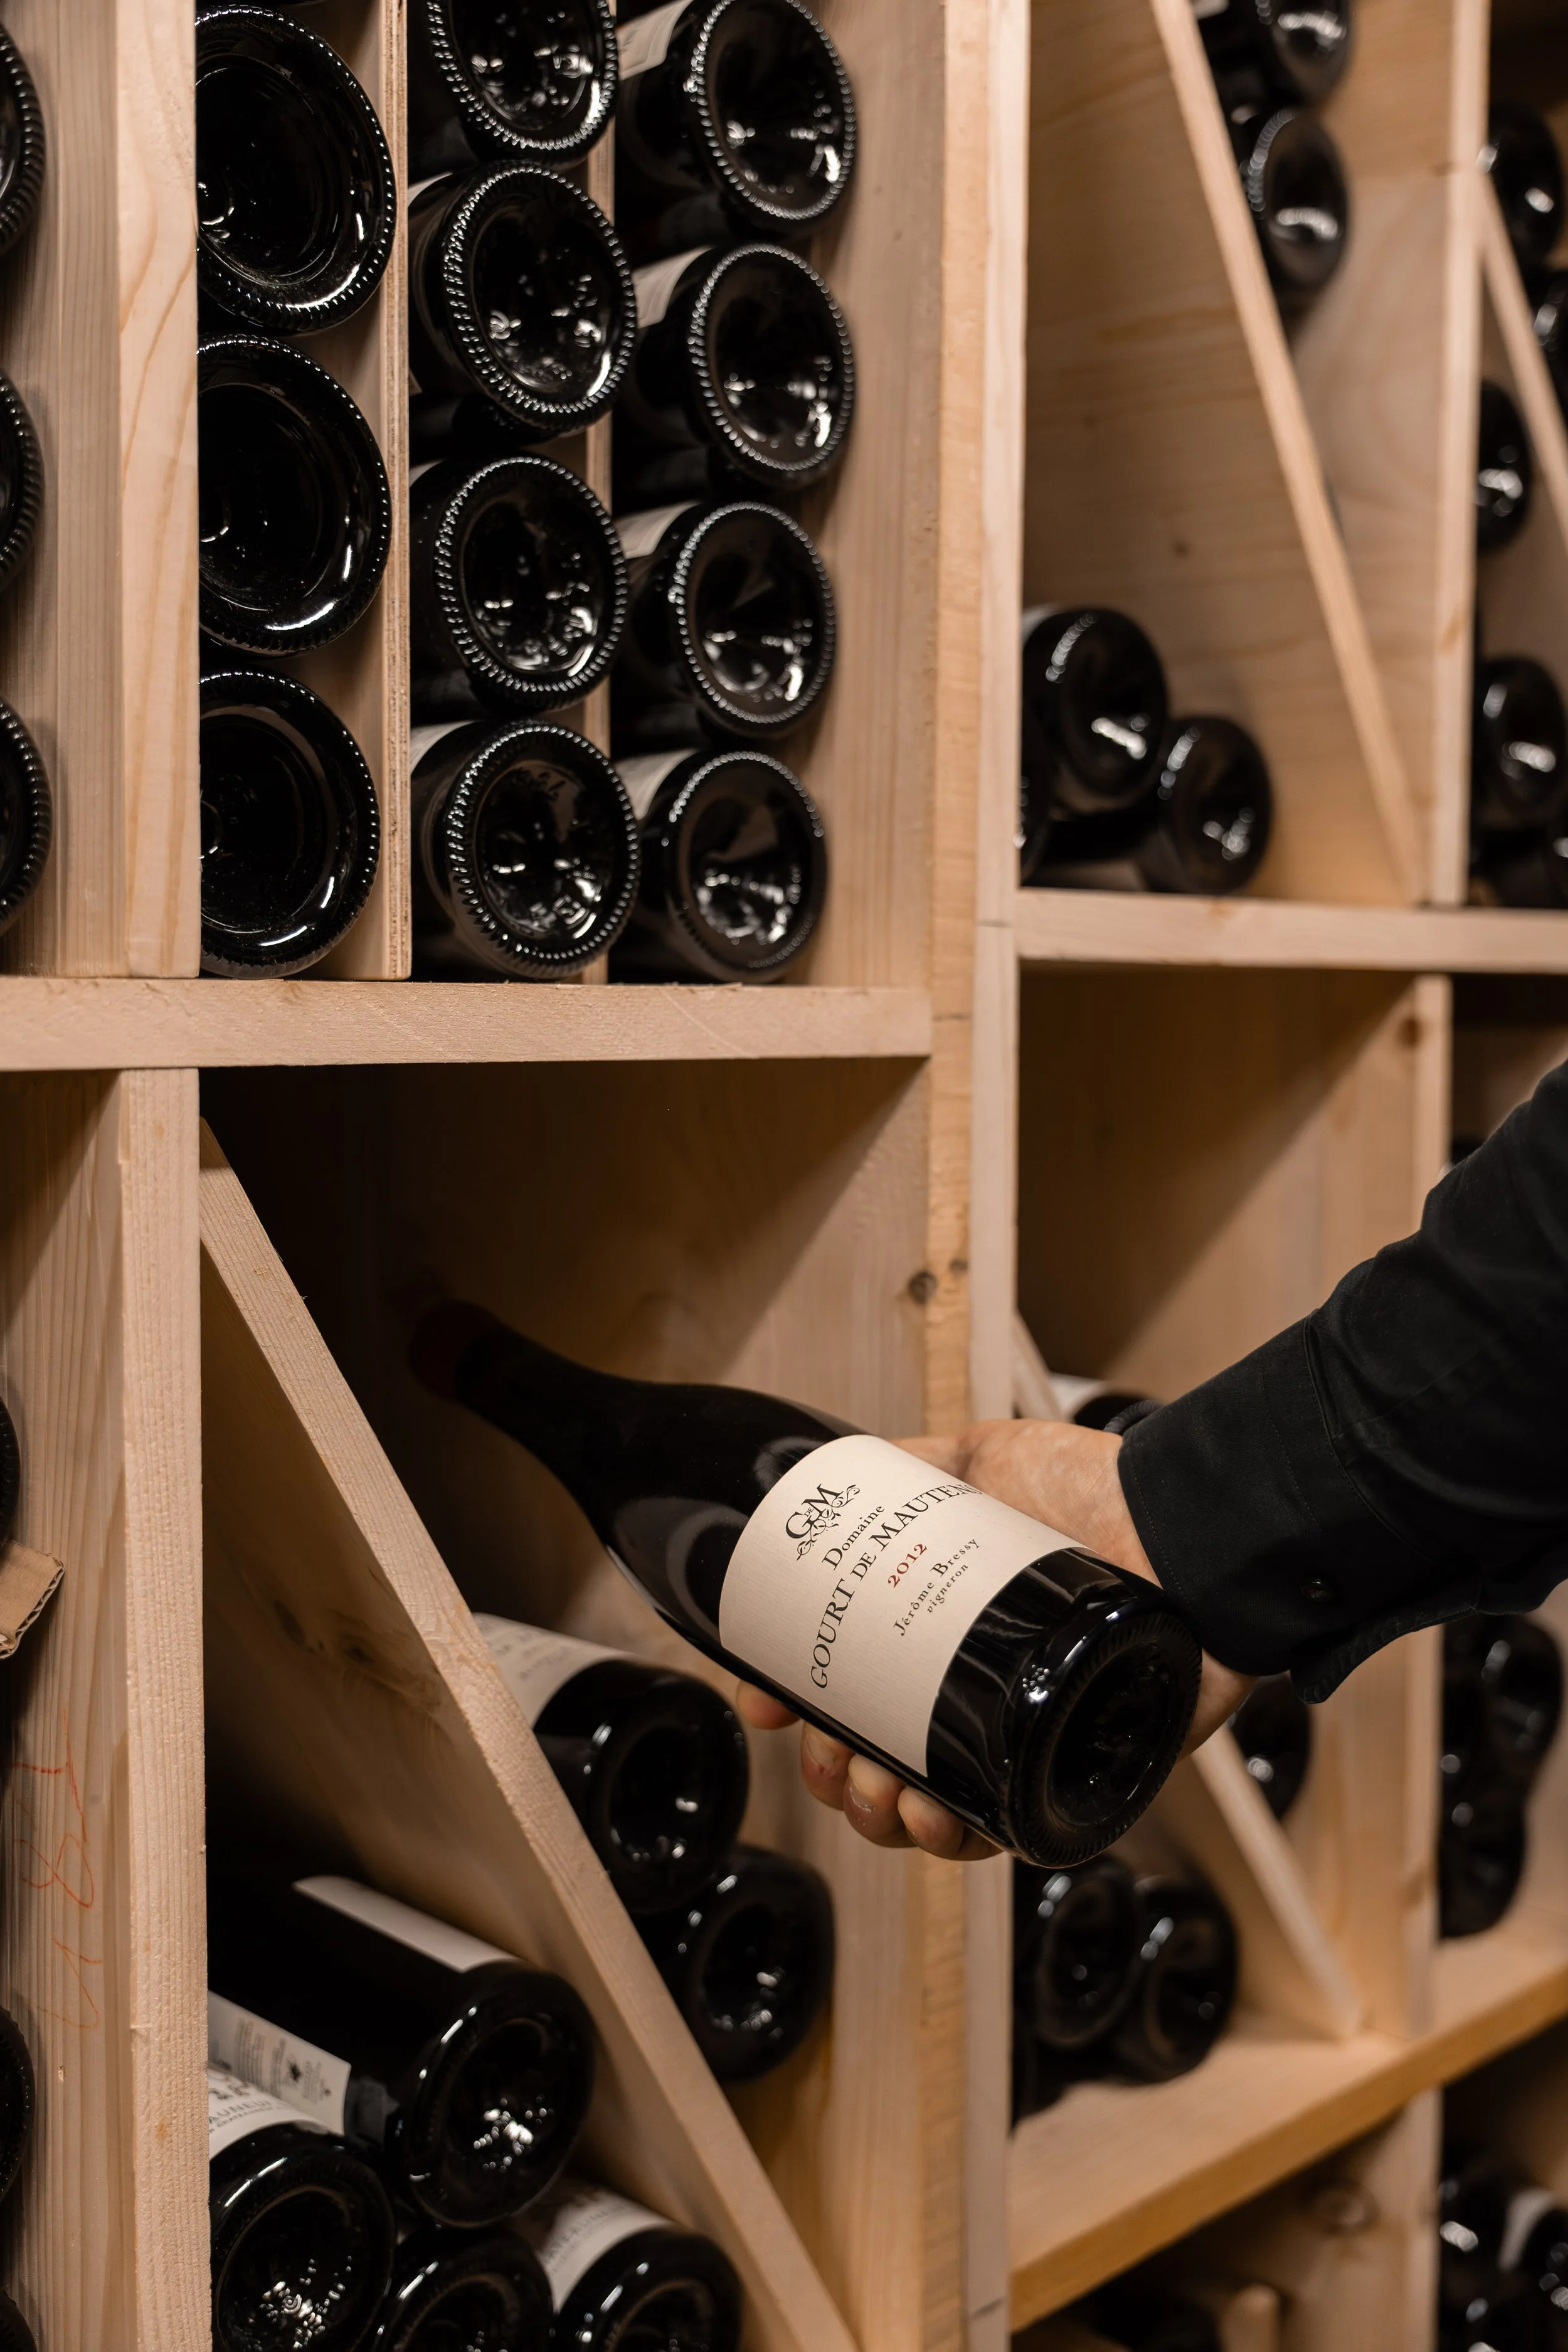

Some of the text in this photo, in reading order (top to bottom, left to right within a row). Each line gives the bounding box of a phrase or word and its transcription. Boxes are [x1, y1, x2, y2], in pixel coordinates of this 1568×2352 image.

[822, 1506, 884, 1571] Domaine
[887, 1544, 928, 1587] 2012
[810, 1578, 855, 1688] GOURT
[850, 1552, 877, 1581] DE
[893, 1539, 980, 1636] Jérôme Bressy
[927, 1564, 968, 1613] vigneron
